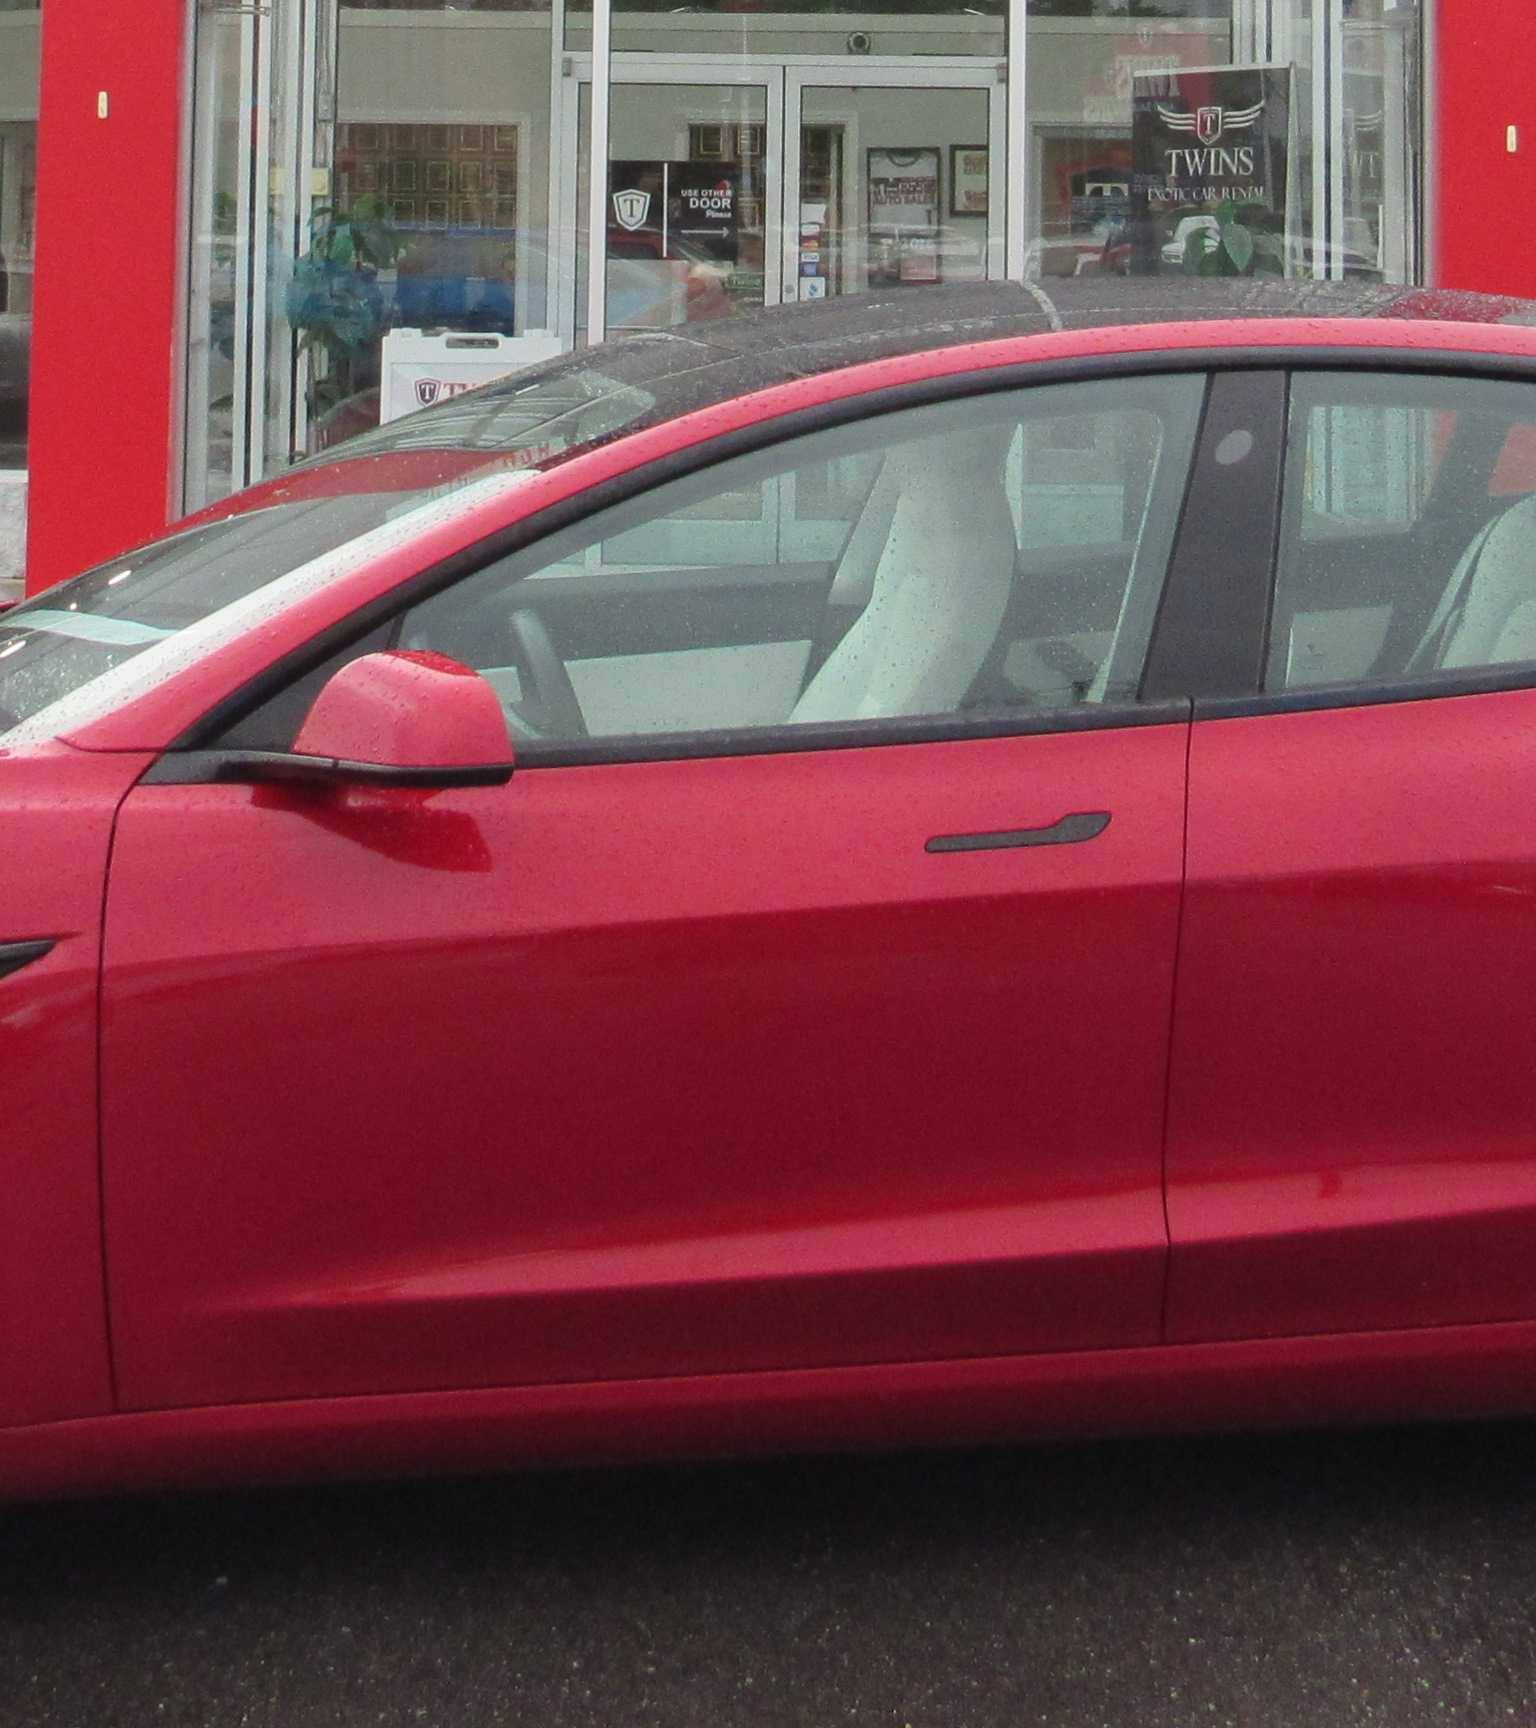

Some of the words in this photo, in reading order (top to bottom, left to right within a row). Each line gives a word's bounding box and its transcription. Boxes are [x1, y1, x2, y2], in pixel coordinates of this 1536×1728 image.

[1165, 146, 1254, 177] TWINS
[1192, 185, 1217, 201] CAR
[623, 198, 641, 218] T
[689, 198, 732, 210] DOOR
[421, 382, 434, 400] T
